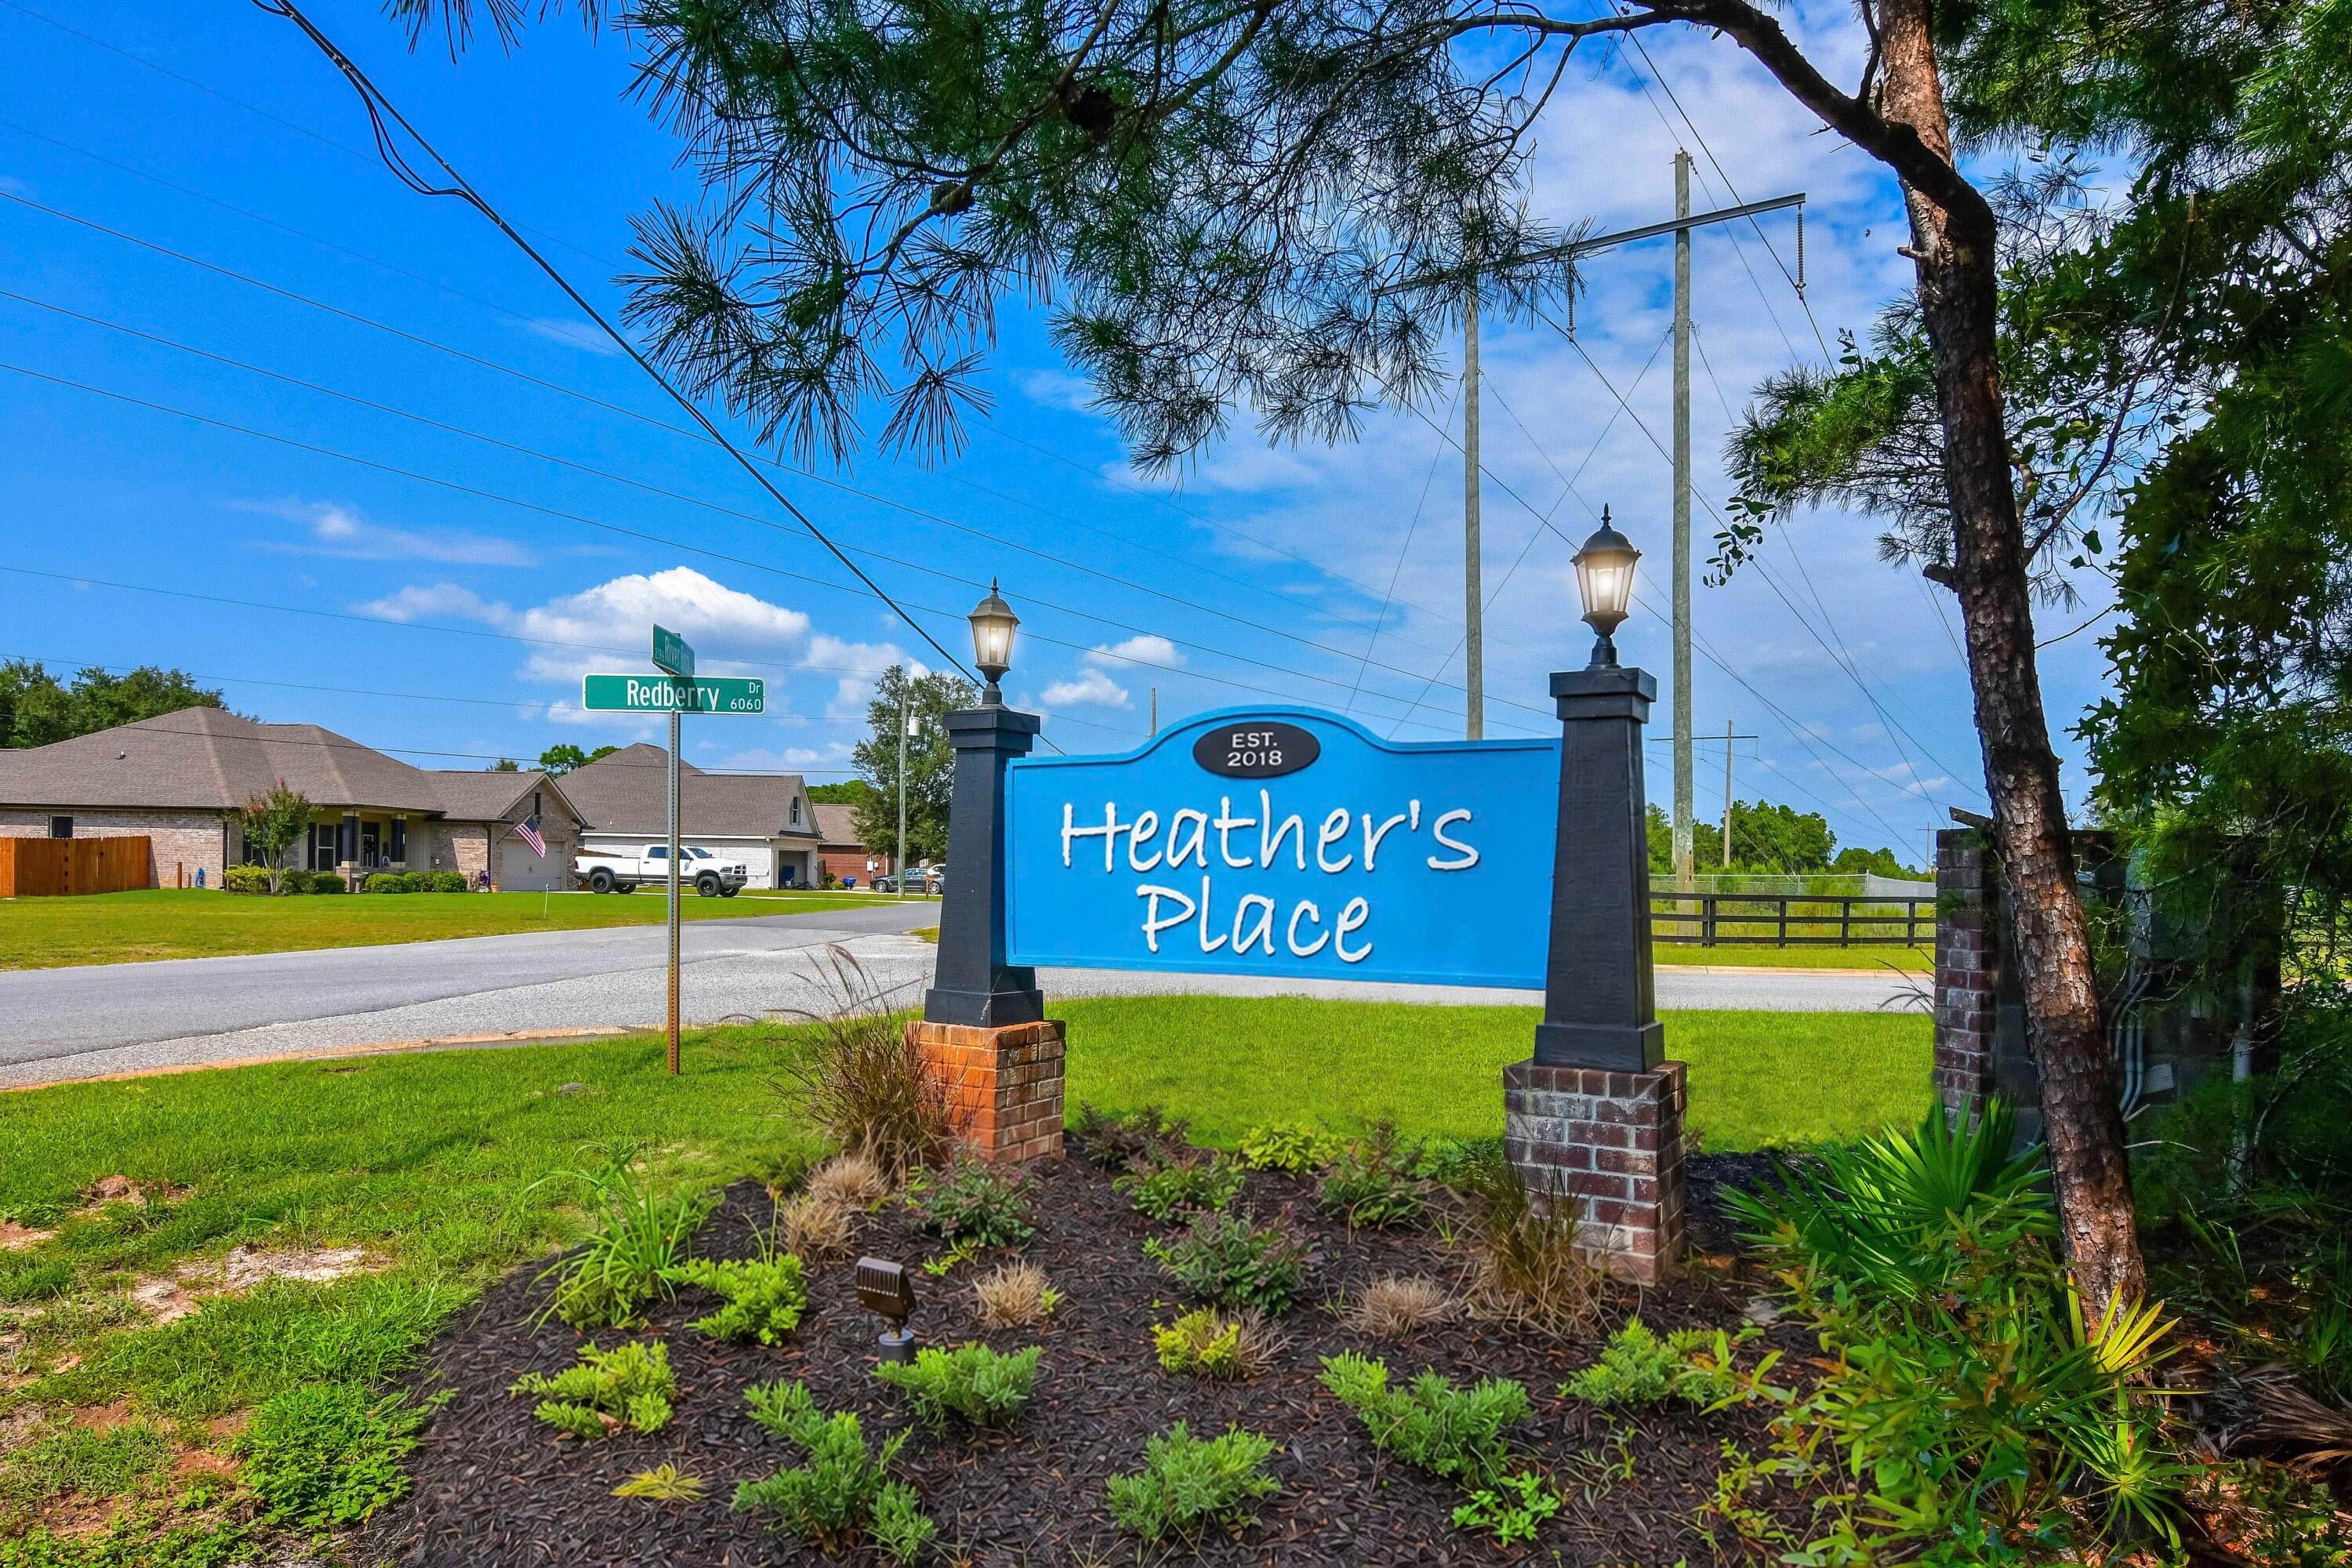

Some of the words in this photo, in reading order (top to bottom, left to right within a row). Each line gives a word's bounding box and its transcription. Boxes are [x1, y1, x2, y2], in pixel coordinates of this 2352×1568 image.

[665, 635, 681, 669] River
[626, 679, 720, 711] Redberry
[749, 682, 761, 694] Dr
[729, 698, 762, 710] 6060
[1232, 731, 1277, 748] EST.
[1227, 750, 1283, 767] 2018
[1061, 789, 1479, 873] Heather's
[1136, 875, 1373, 963] Place
